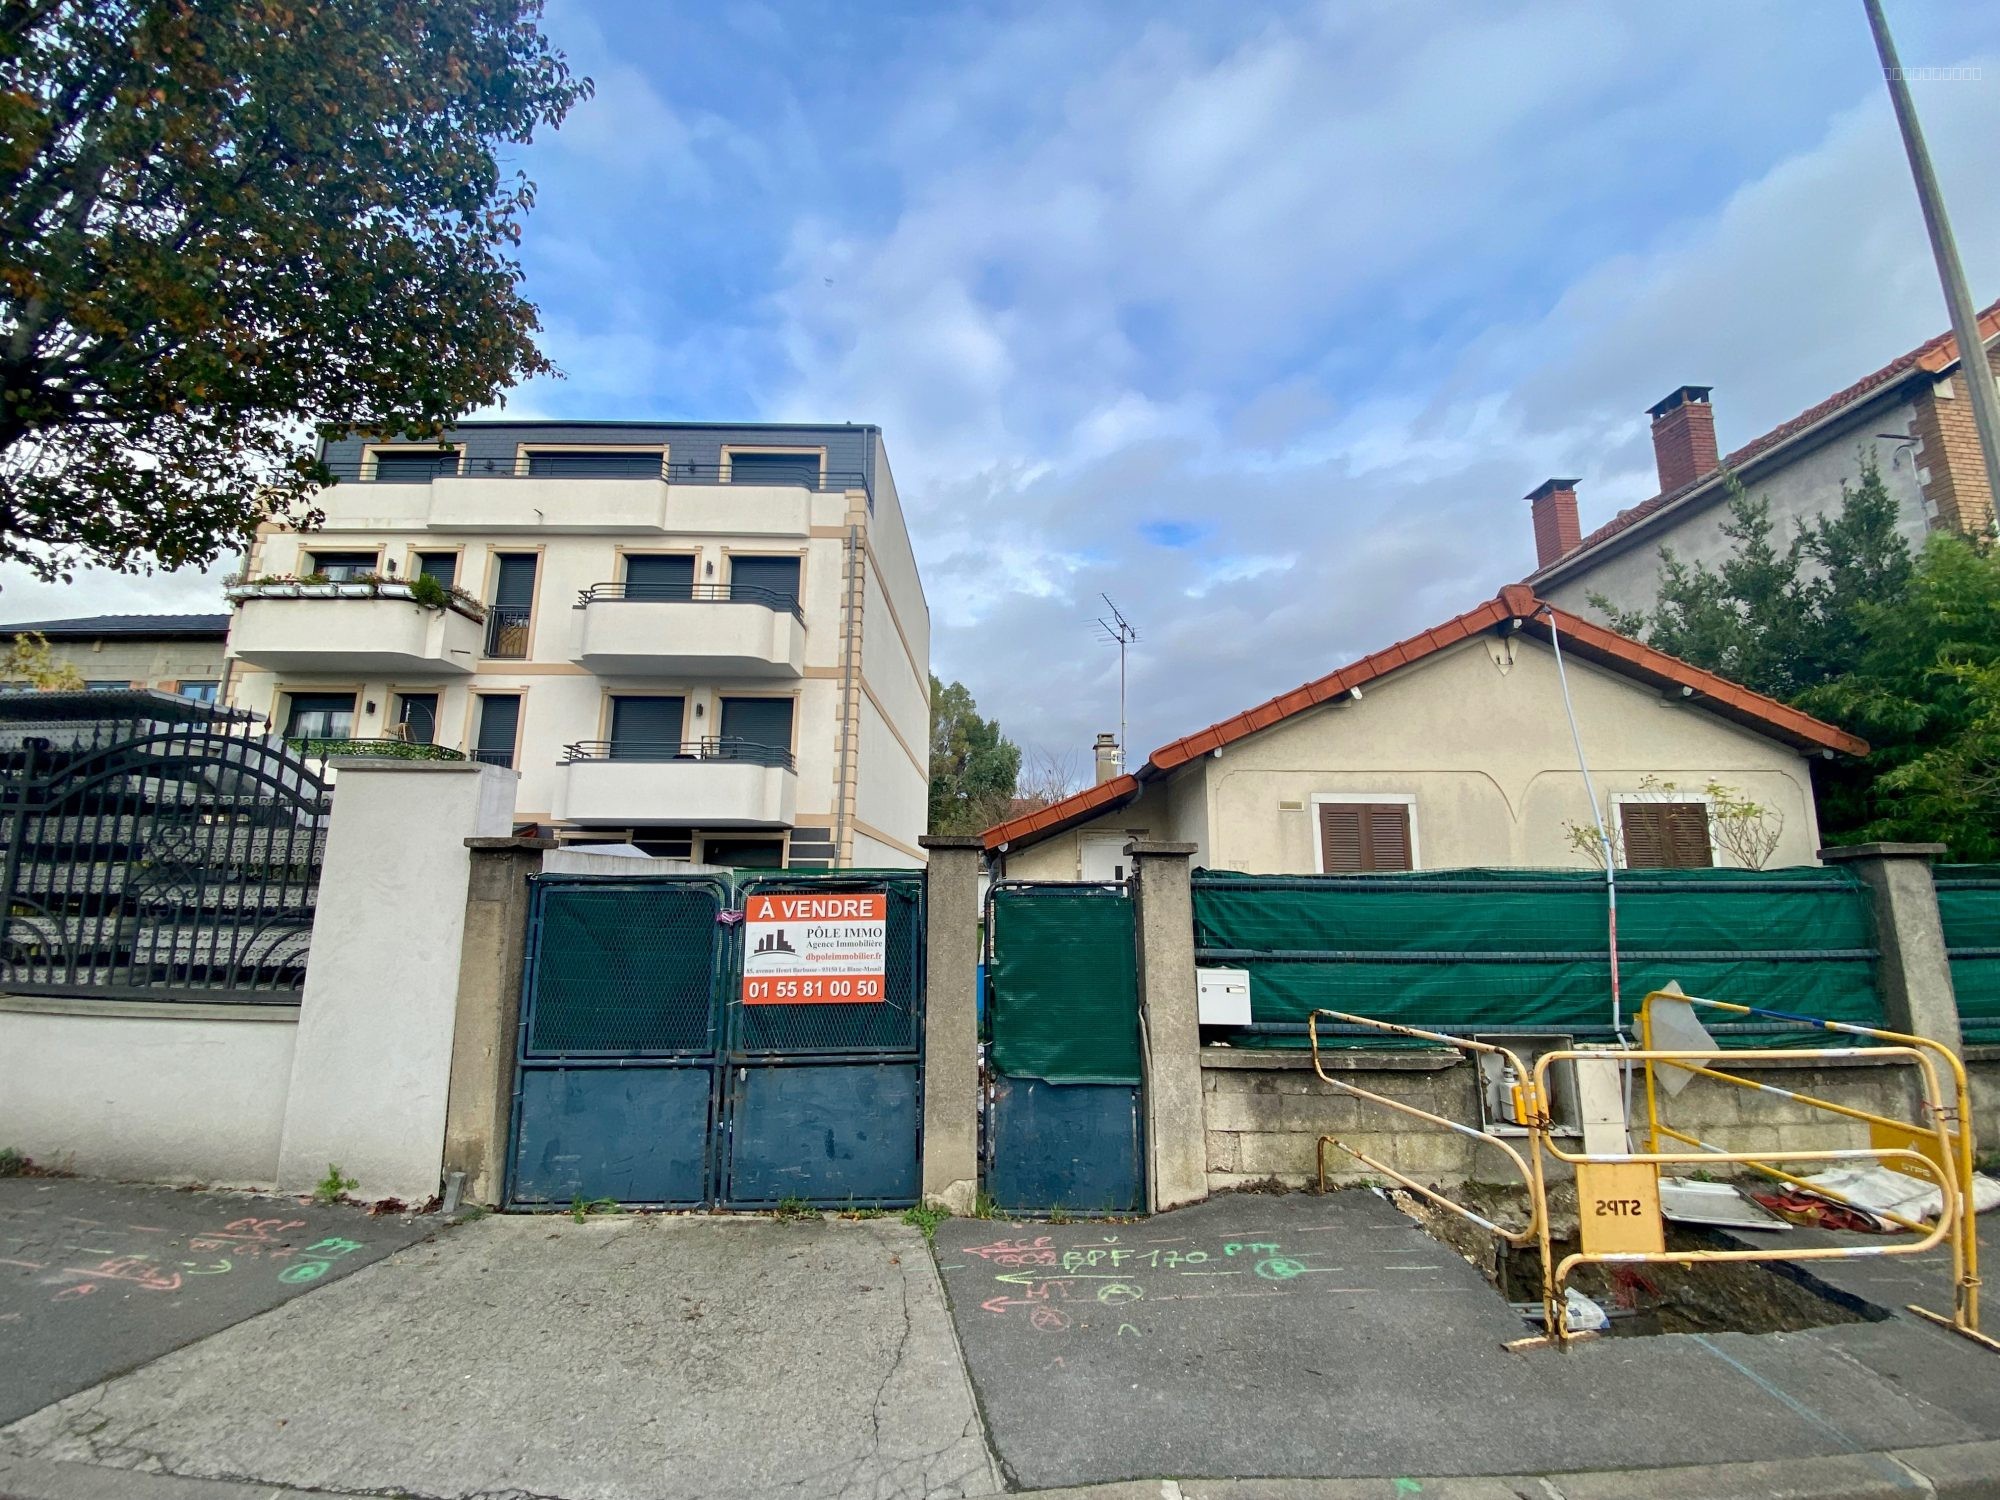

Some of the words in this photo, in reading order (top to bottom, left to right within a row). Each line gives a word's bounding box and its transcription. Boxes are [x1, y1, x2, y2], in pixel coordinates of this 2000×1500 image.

[758, 897, 775, 919] À
[781, 899, 873, 918] VENDRE
[806, 926, 842, 939] PÔLE
[844, 927, 883, 938] IMMO
[806, 940, 834, 949] Agence
[836, 940, 883, 948] Immobilière
[805, 952, 882, 962] dbpoleimmobilier.fr
[748, 982, 769, 998] 01
[776, 981, 797, 998] 55
[802, 981, 823, 997] 81
[830, 980, 851, 997] 00
[857, 980, 878, 996] 50
